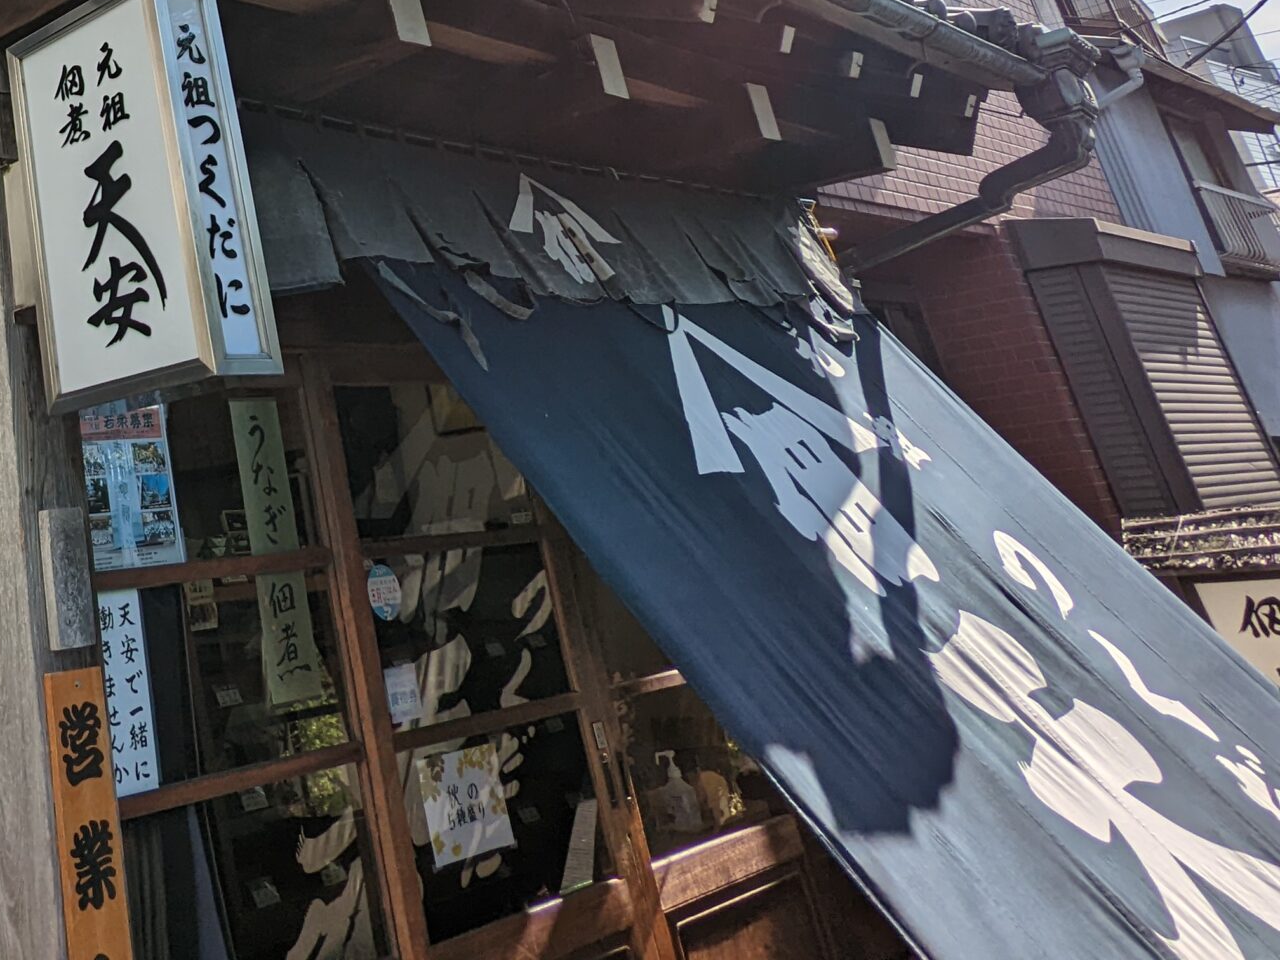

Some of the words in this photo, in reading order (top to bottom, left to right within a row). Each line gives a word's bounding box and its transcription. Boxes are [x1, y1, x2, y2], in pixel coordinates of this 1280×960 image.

[54, 64, 91, 148] 佃煮
[96, 42, 130, 133] 元祖
[176, 24, 251, 319] 元祖つくだに
[81, 140, 167, 347] 天安
[248, 415, 287, 545] うなぎ
[118, 602, 151, 782] 天安で一緒に
[59, 701, 117, 960] 営業
